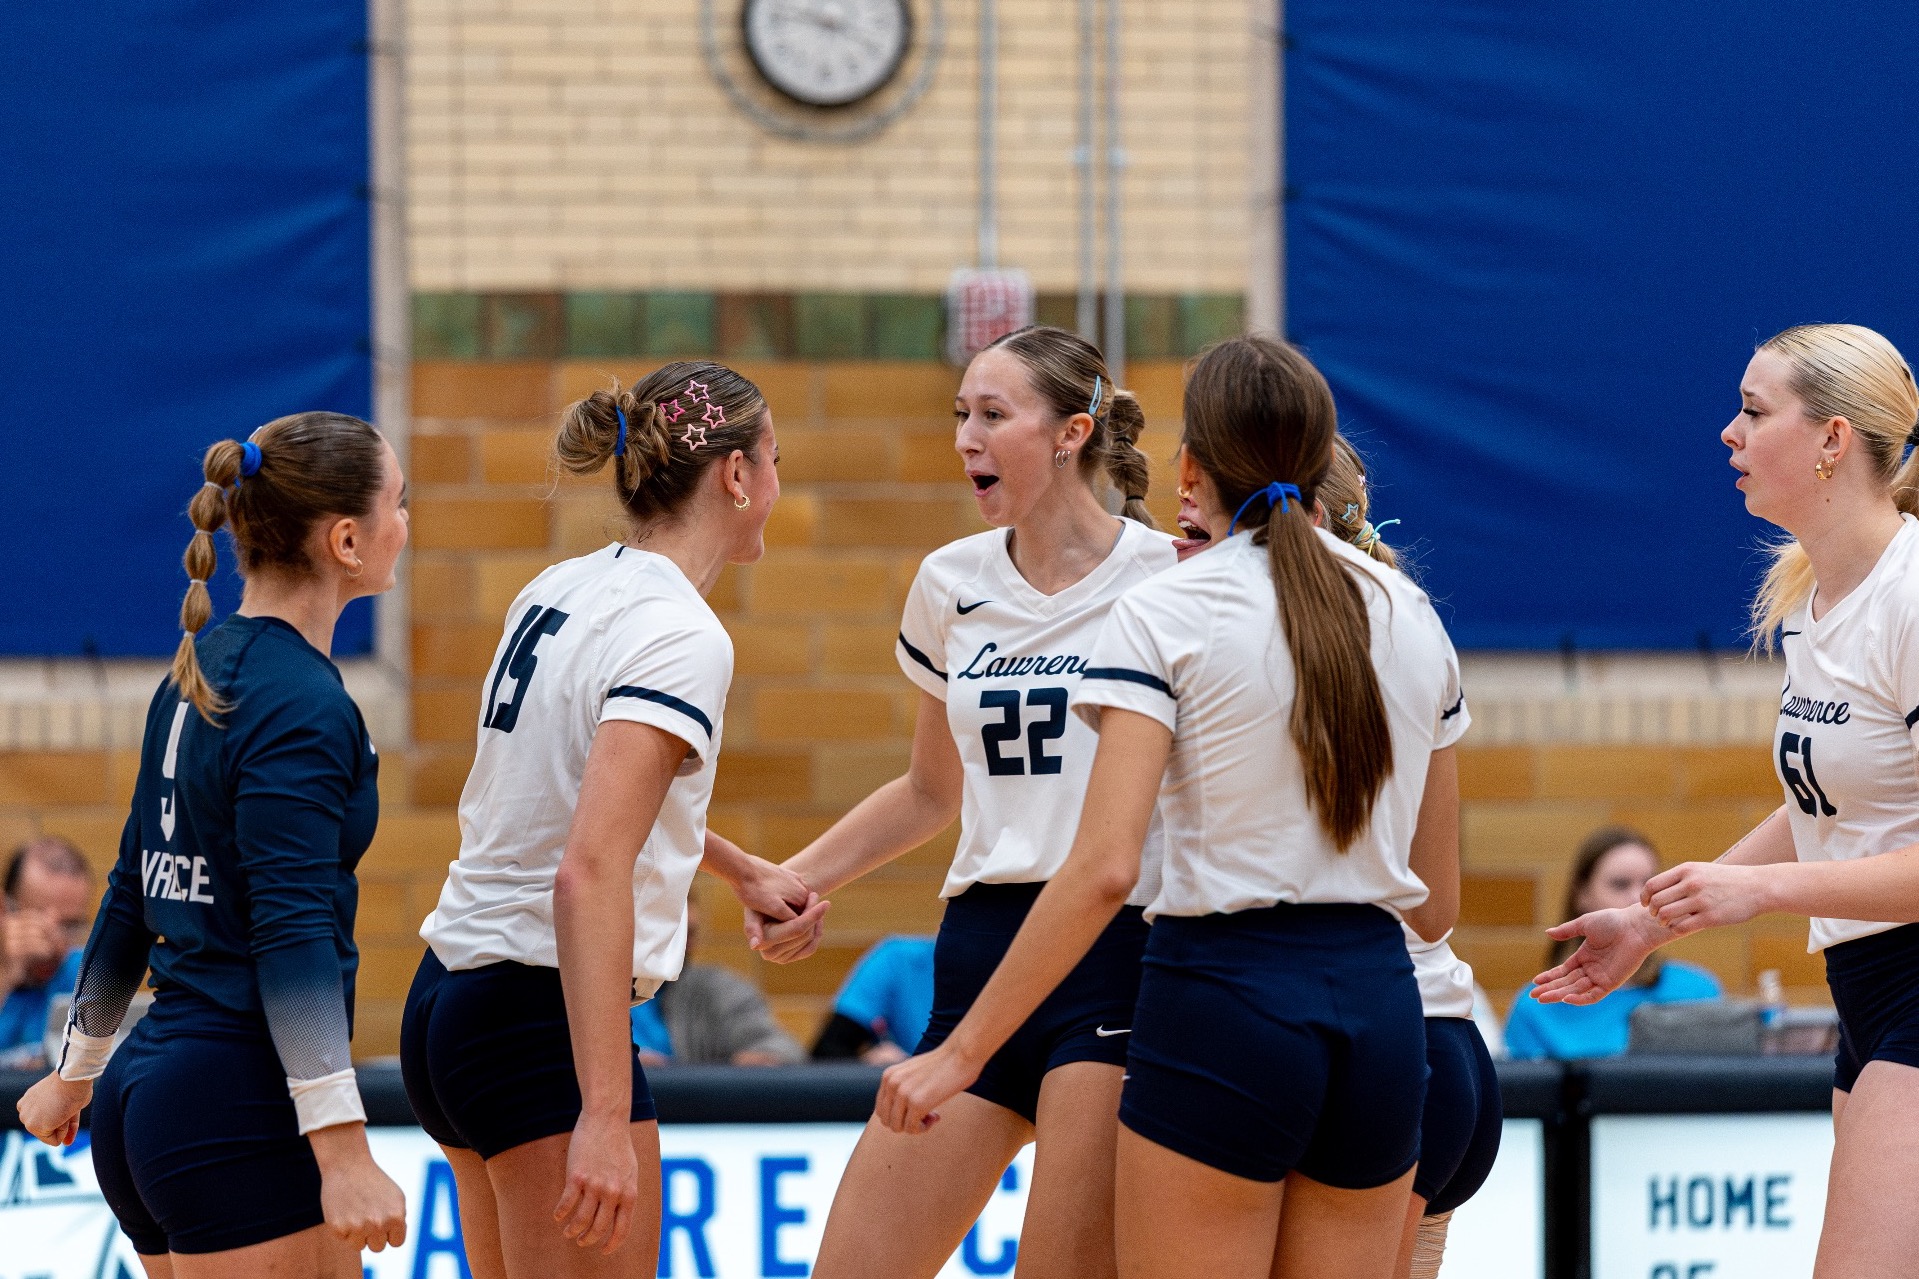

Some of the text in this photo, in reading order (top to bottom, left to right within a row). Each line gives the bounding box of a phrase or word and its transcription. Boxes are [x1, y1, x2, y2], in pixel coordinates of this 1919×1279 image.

[483, 604, 571, 733] 15
[957, 642, 1090, 680] Lawren
[979, 687, 1068, 776] 22
[1779, 731, 1837, 817] 61
[1648, 1173, 1792, 1229] HOME
